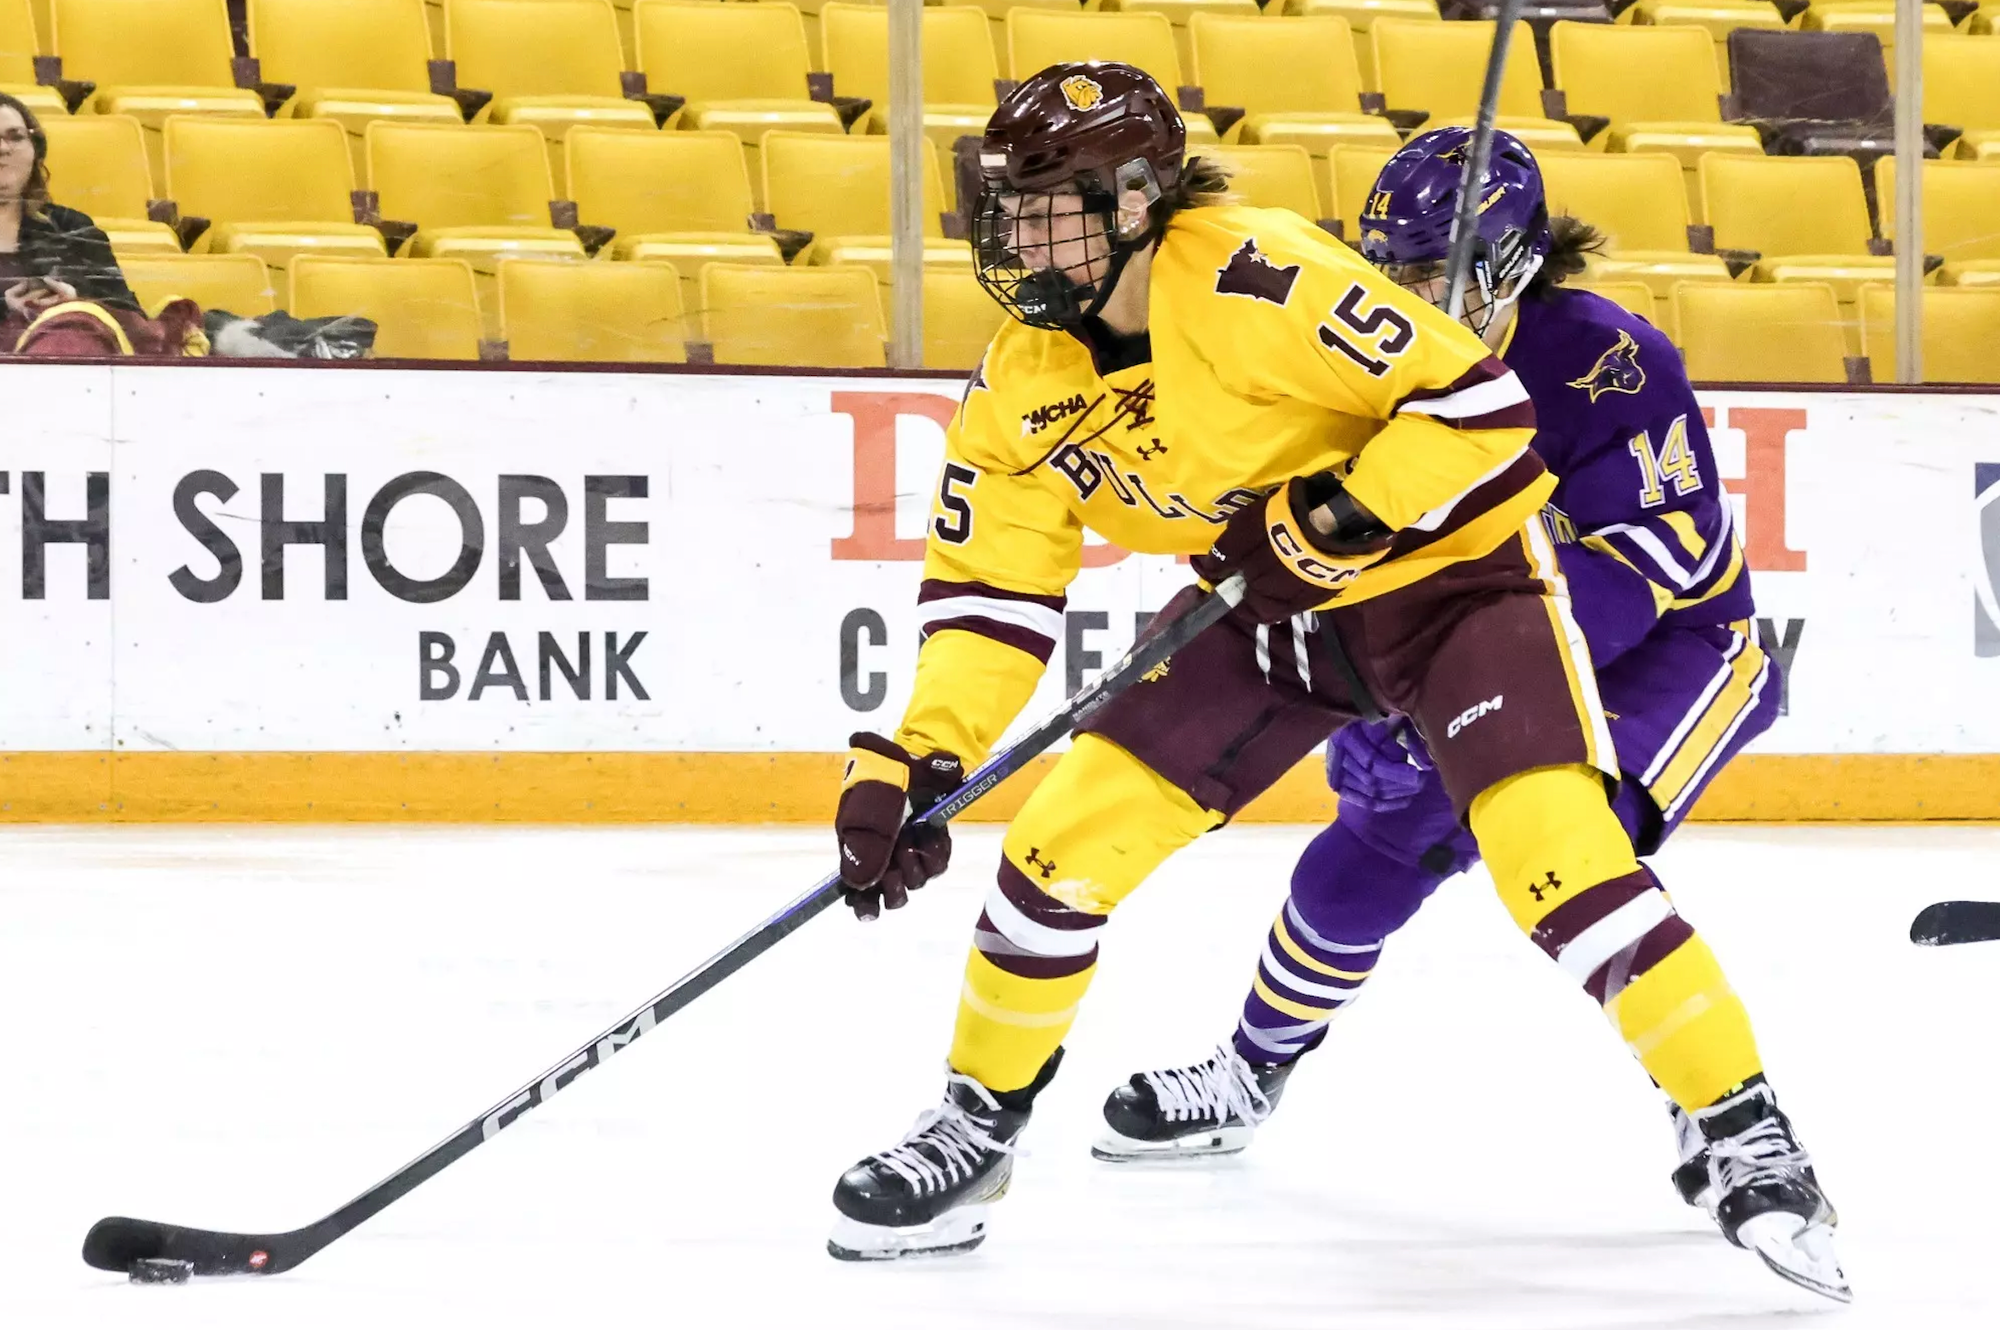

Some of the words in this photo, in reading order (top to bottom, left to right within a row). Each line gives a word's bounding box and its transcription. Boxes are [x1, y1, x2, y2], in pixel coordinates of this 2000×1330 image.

[1369, 193, 1392, 220] 14
[1476, 184, 1507, 215] AUER
[1317, 282, 1415, 379] 15
[1021, 393, 1088, 435] WCHA
[1628, 413, 1704, 509] 14
[0, 471, 110, 603] H
[167, 469, 650, 604] SHORE
[927, 461, 979, 547] 5
[419, 631, 651, 701] BANK
[1447, 694, 1504, 739] CCM
[939, 773, 998, 819] TRIGGER
[482, 1005, 657, 1141] CCM
